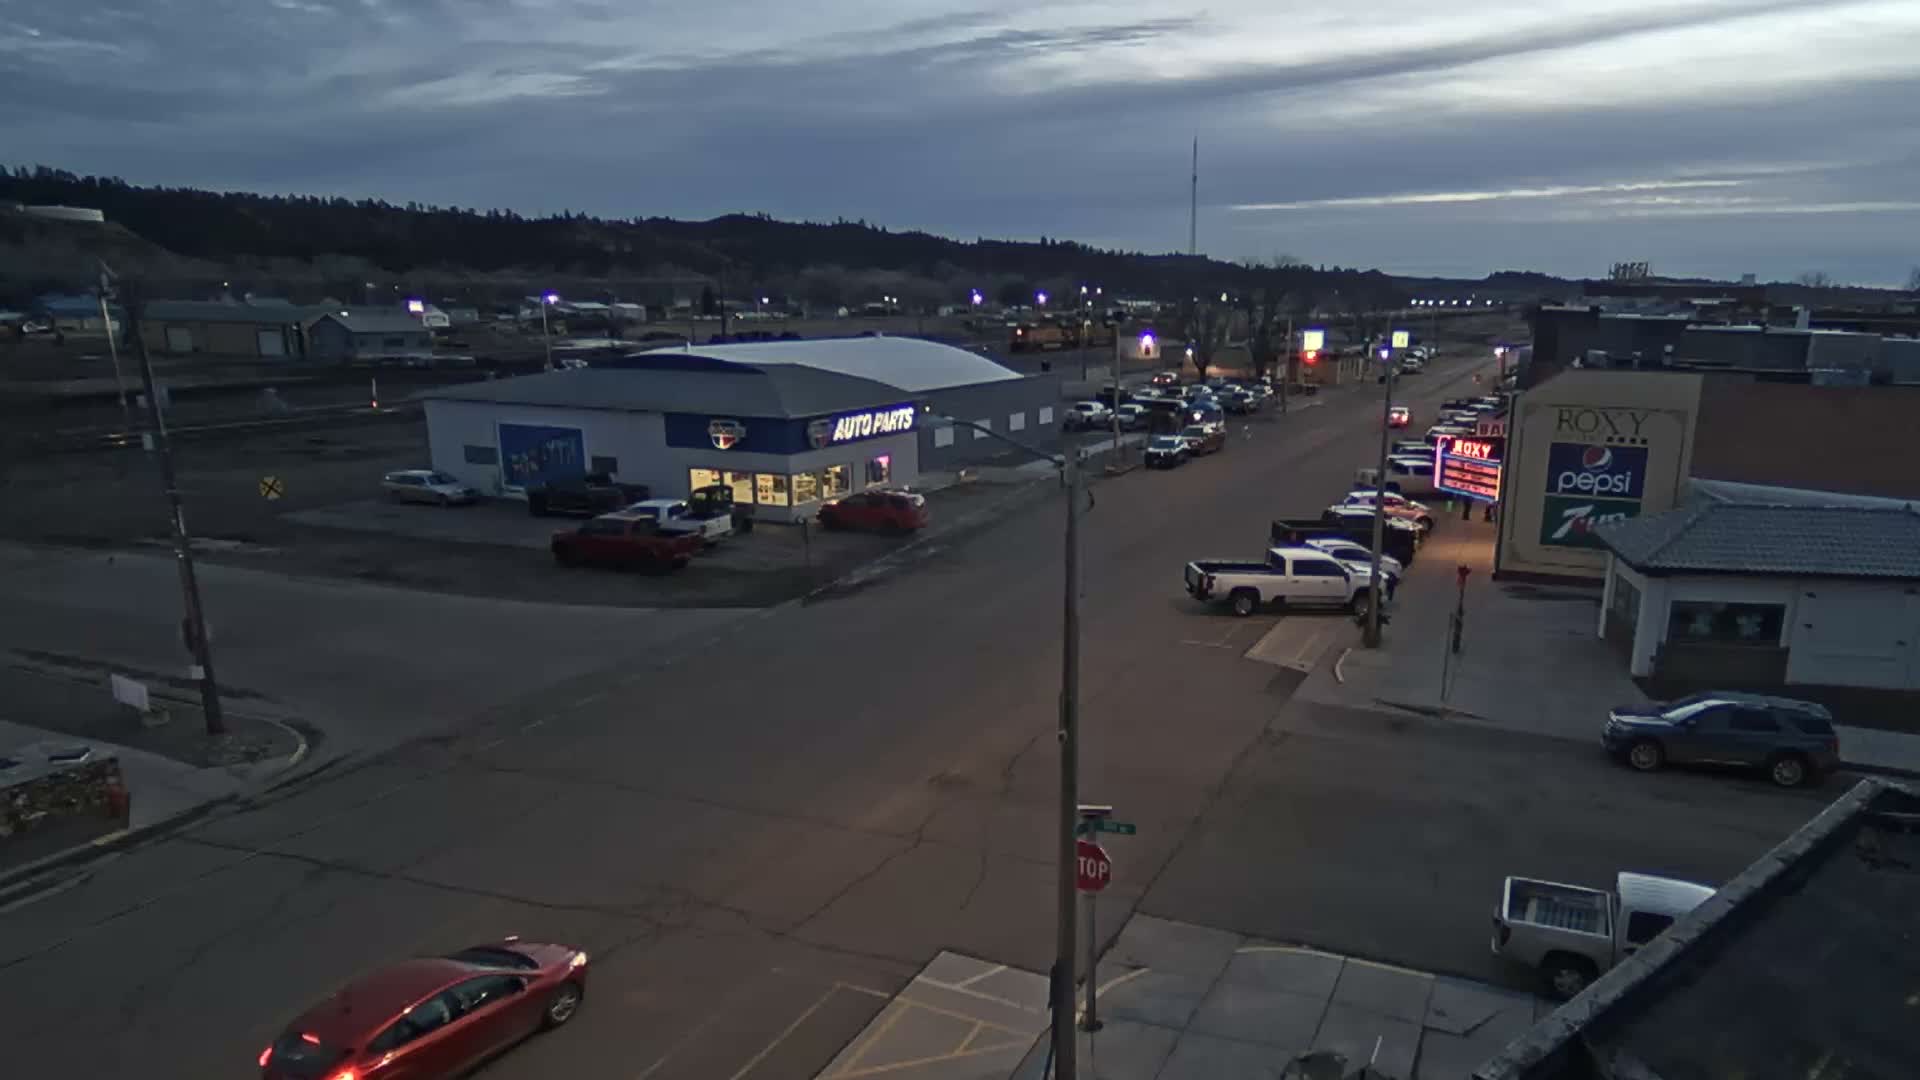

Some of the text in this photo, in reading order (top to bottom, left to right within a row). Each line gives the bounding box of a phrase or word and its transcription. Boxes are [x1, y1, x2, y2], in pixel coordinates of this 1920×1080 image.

[833, 407, 914, 441] AUTO PARTS
[1480, 423, 1505, 436] BA
[1556, 408, 1649, 435] ROXY
[1452, 439, 1491, 458] ROXY
[1557, 471, 1632, 496] pepsi
[1077, 856, 1109, 880] TOP
